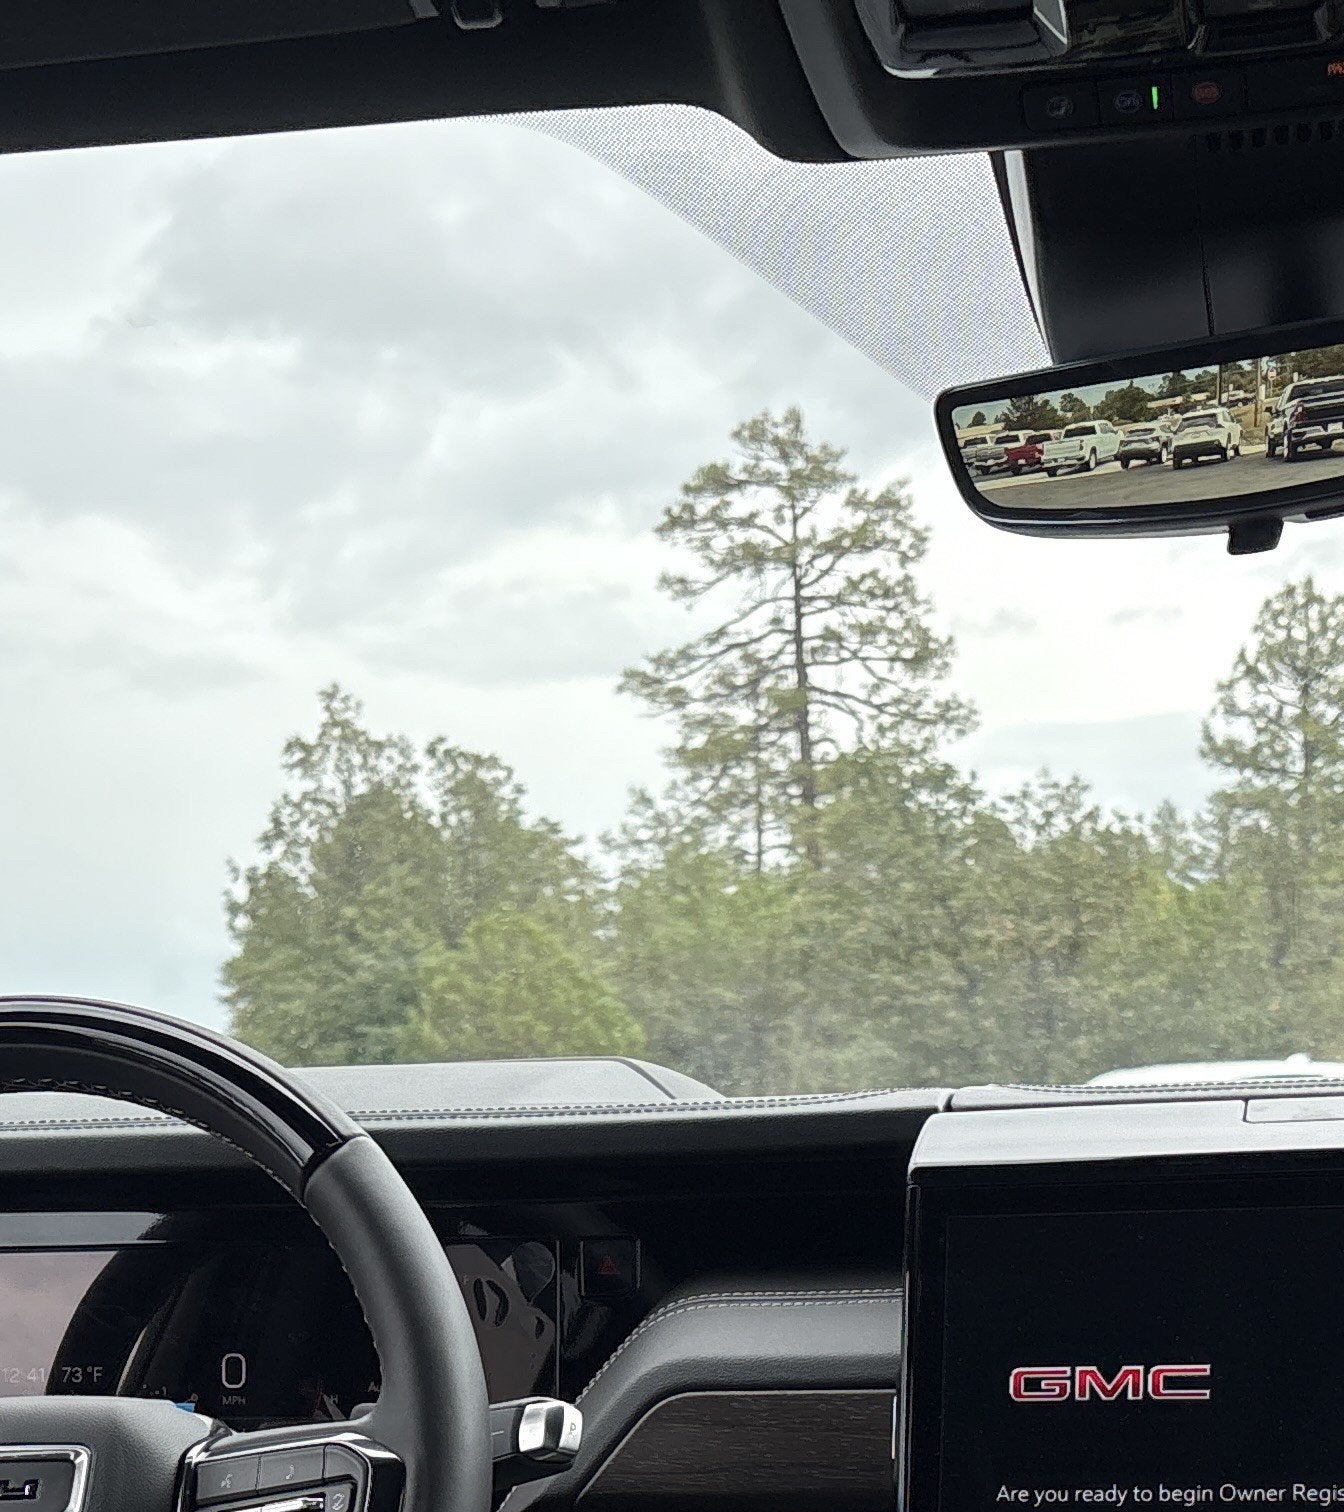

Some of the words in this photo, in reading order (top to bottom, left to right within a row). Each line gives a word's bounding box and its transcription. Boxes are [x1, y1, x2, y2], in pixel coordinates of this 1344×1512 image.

[61, 1367, 83, 1384] 73
[221, 1352, 247, 1389] 0
[1009, 1363, 1211, 1402] GMC
[222, 1395, 246, 1406] MPH
[996, 1484, 1030, 1503] Are
[1034, 1487, 1069, 1508] you
[1074, 1484, 1130, 1507] ready
[1132, 1486, 1153, 1503] to
[1158, 1484, 1214, 1508] begin
[1218, 1484, 1287, 1503] Owner
